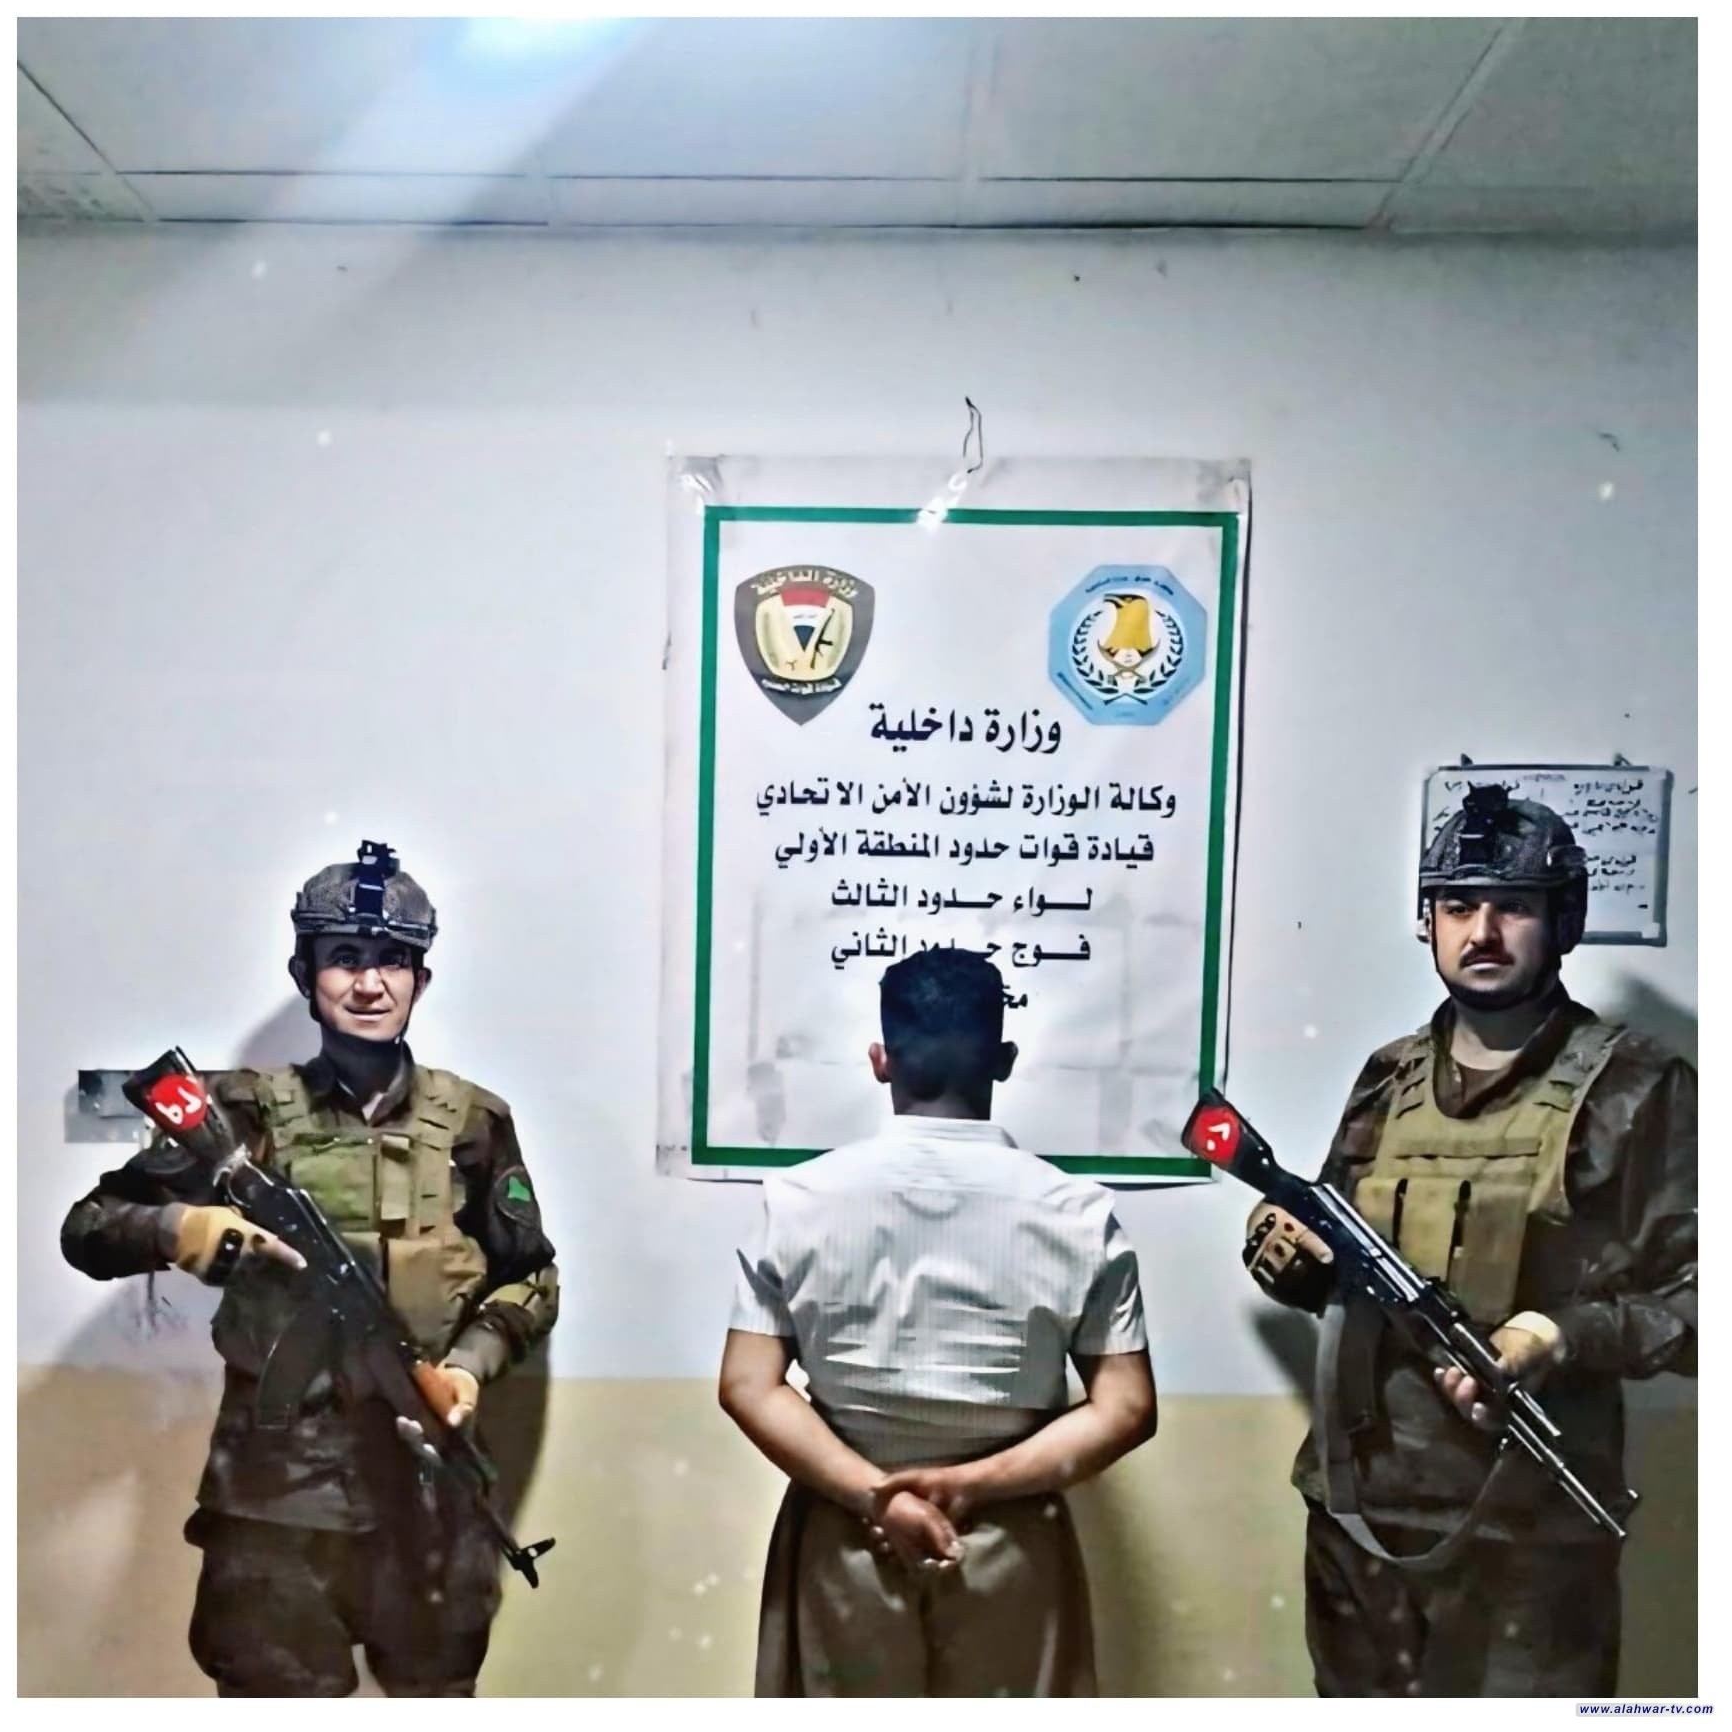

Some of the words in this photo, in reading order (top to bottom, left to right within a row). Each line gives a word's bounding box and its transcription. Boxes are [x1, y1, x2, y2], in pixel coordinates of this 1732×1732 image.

[869, 702, 974, 753] داخلية
[984, 708, 1061, 755] وزارة
[871, 777, 930, 815] الأمن
[939, 779, 1014, 816] لشؤون
[1021, 783, 1100, 817] الوزارة
[1108, 782, 1176, 819] وكالة
[855, 829, 939, 858] المنطقة
[949, 839, 1010, 866] حدود
[1019, 833, 1079, 868] قوات
[1087, 834, 1154, 869] قيادة
[831, 877, 908, 907] الثالث
[917, 888, 1003, 915] حدود
[1013, 887, 1093, 918] لواء
[831, 927, 908, 971] الثاني
[1012, 934, 1091, 968] فوج
